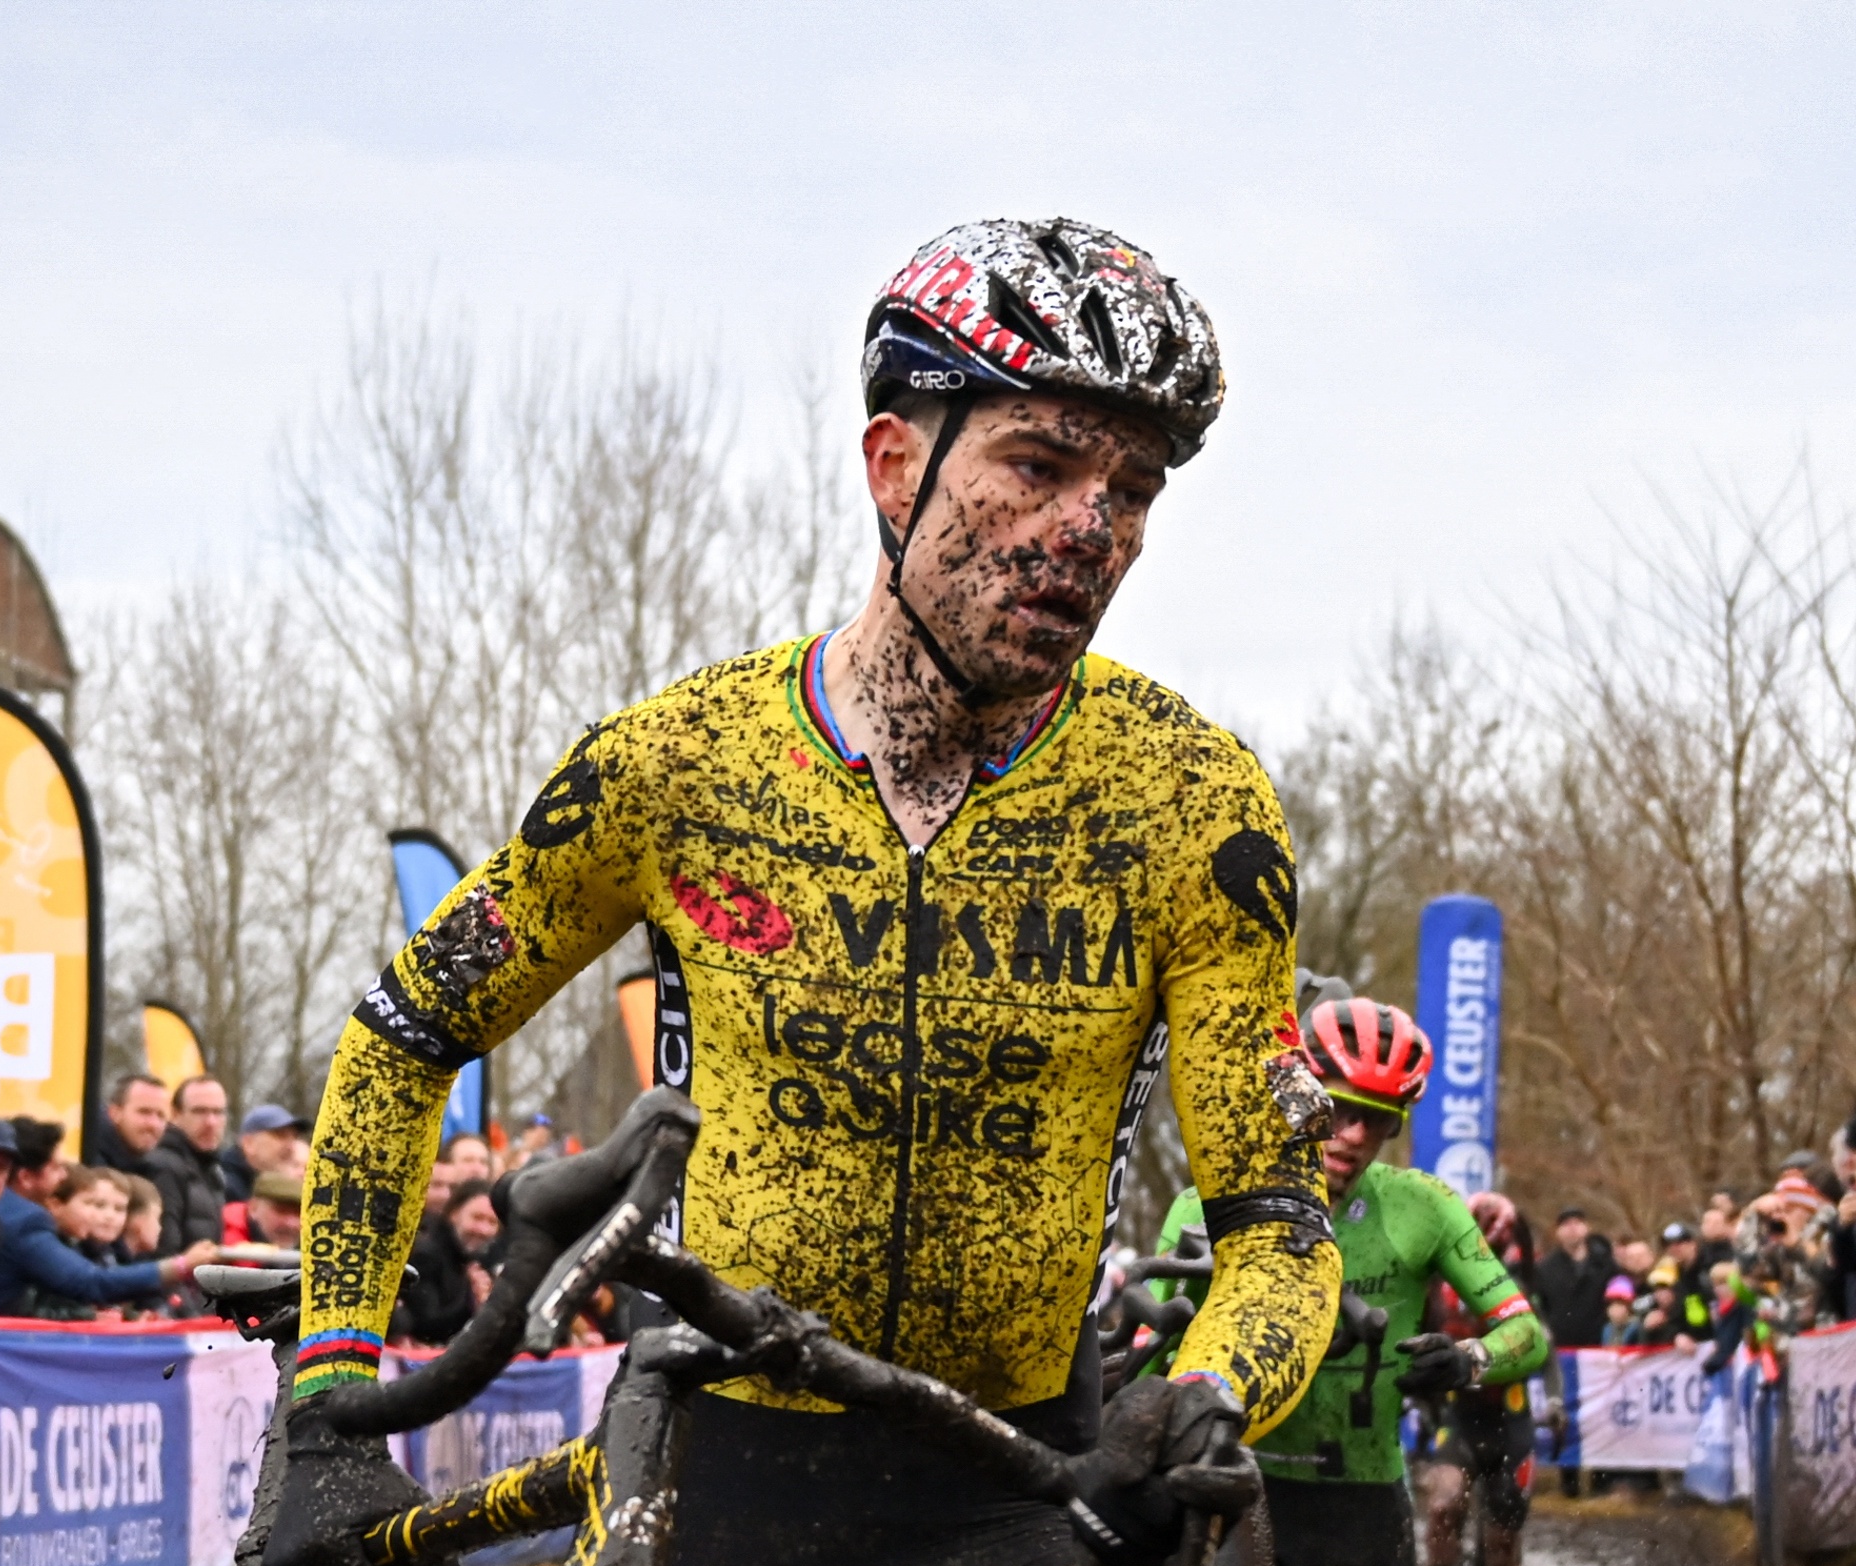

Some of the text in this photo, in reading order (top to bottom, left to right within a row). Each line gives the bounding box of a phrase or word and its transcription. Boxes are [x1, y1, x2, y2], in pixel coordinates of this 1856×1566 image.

[910, 370, 965, 389] GIRO
[827, 892, 1138, 988] VISMA
[764, 993, 1045, 1084] lease
[1441, 936, 1488, 1140] DE CEUSTER
[335, 1233, 373, 1307] FOOD
[1649, 1374, 1676, 1414] DE
[1813, 1385, 1840, 1456] DE
[48, 1402, 164, 1511] CEUSTER
[120, 1518, 163, 1564] GRUES
